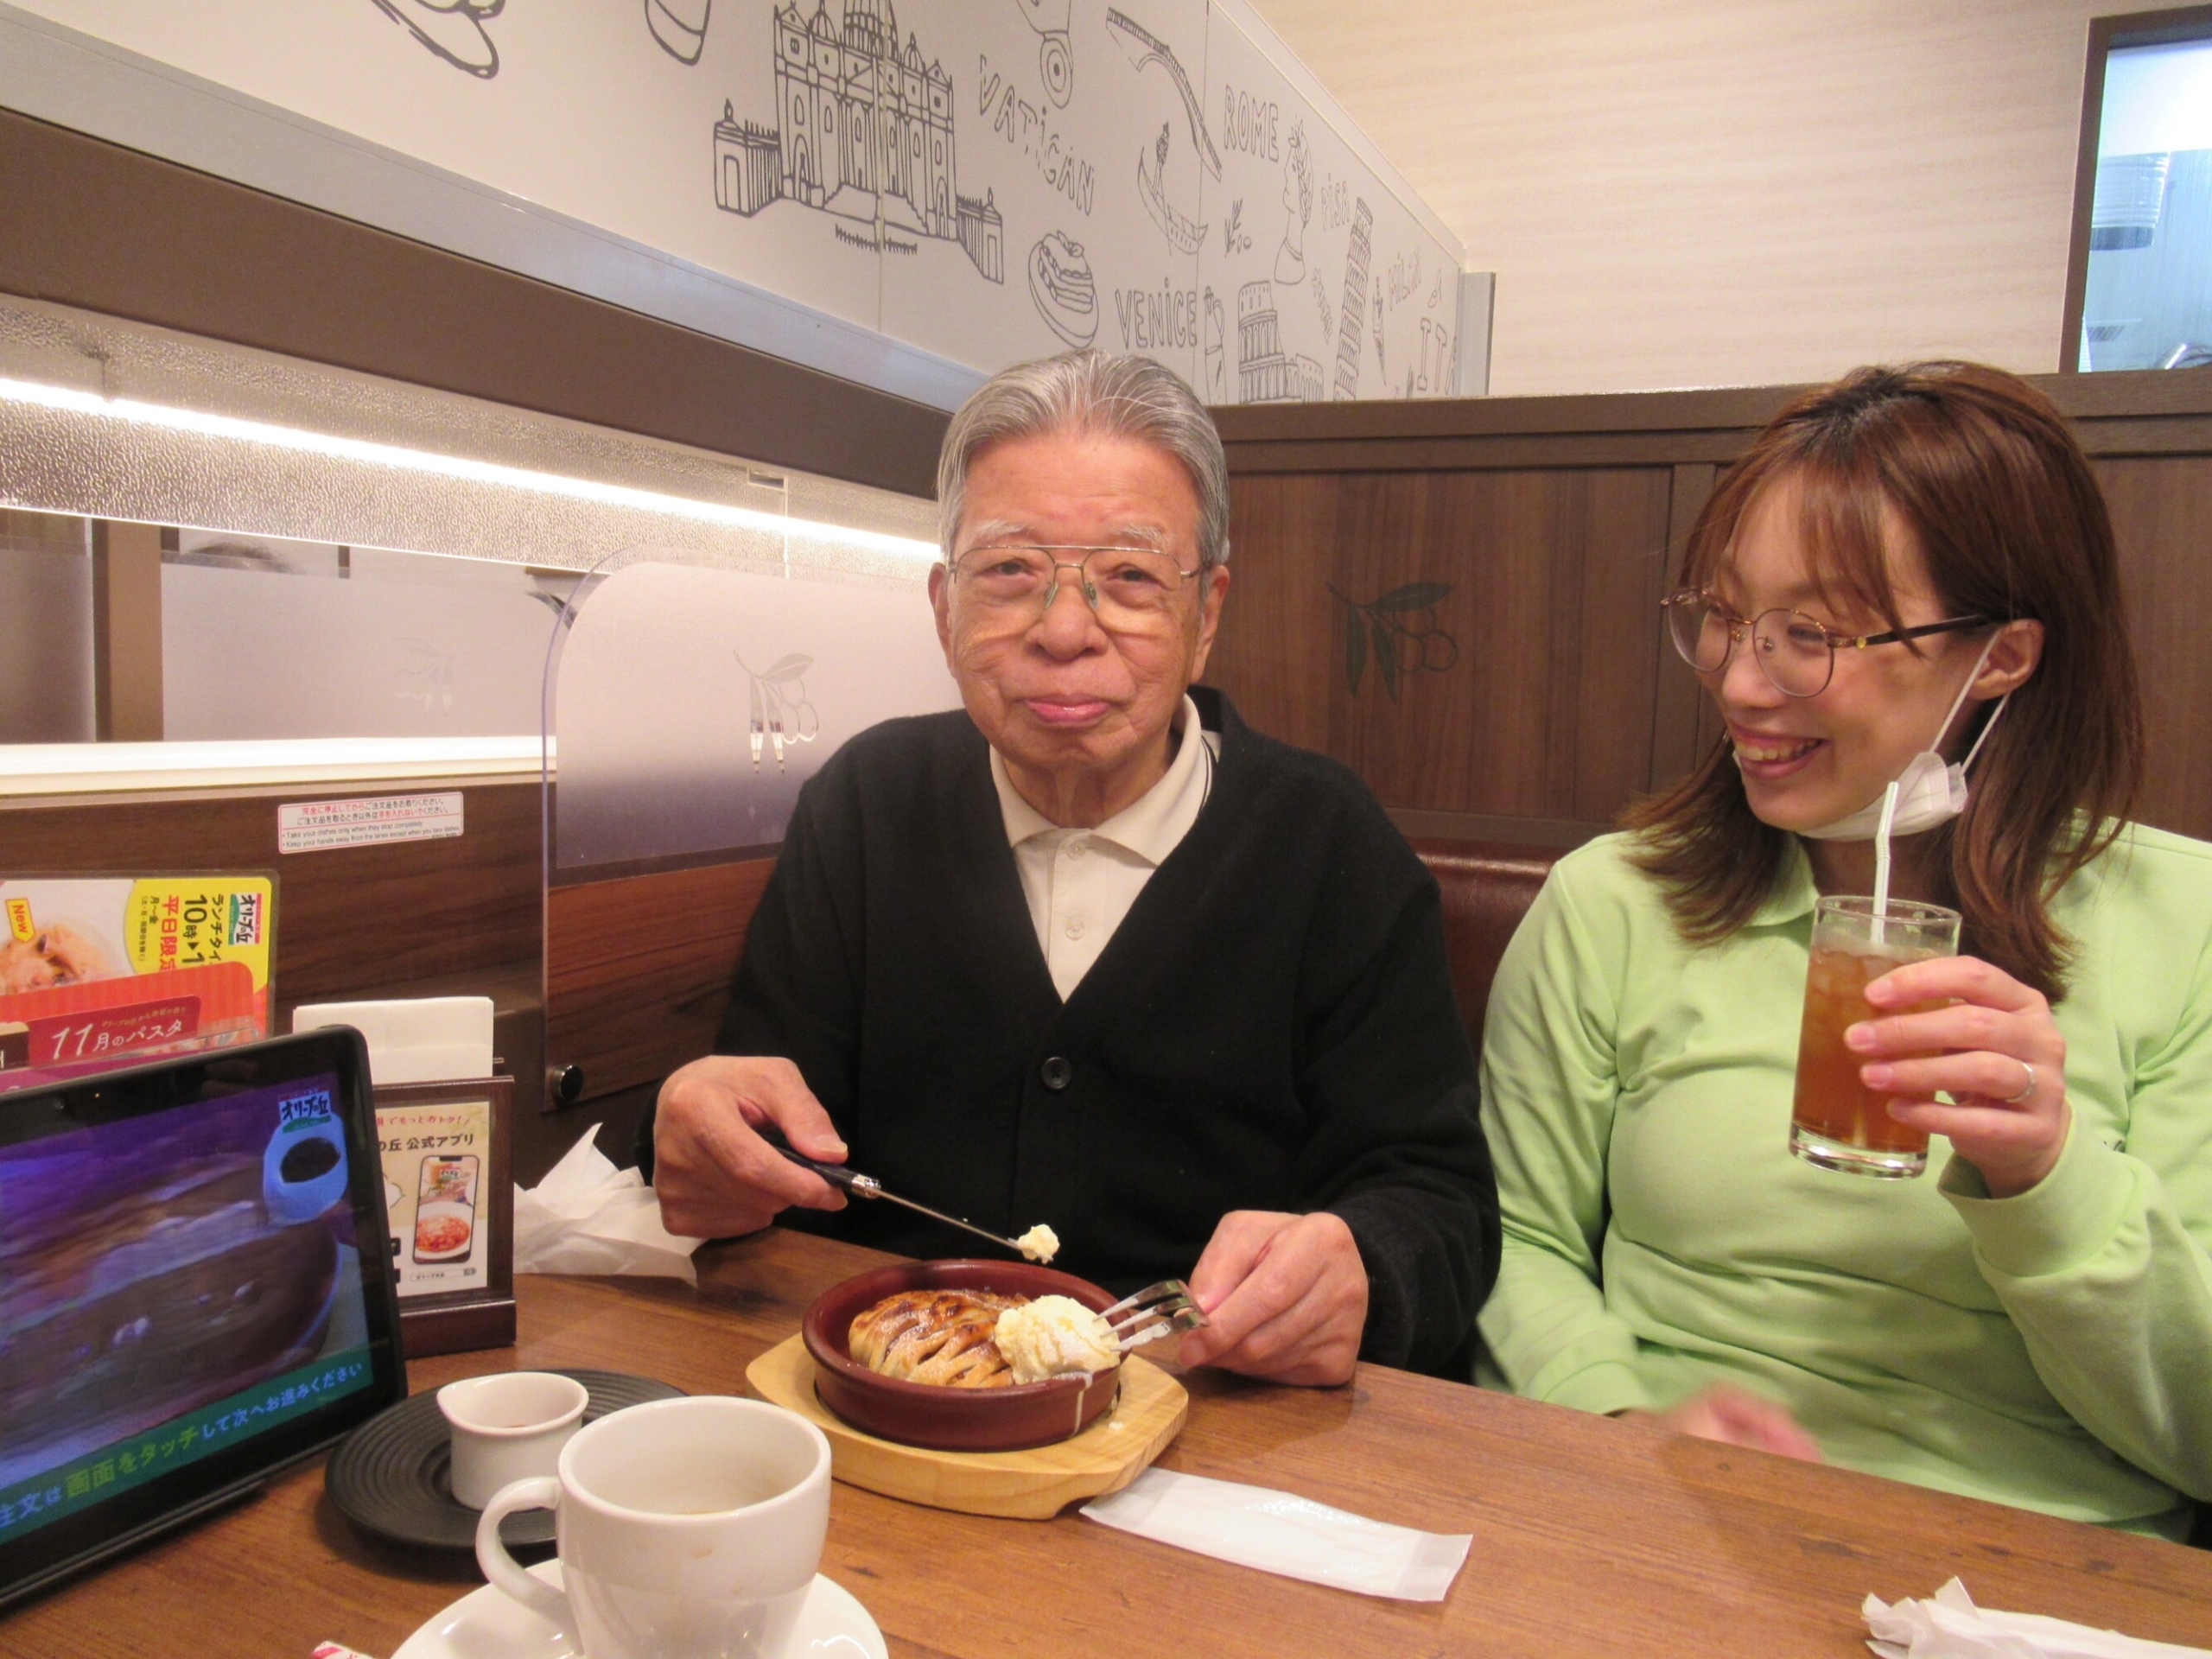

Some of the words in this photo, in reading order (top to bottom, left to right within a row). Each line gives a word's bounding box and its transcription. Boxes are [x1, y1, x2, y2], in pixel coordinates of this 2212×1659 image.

[1224, 85, 1279, 162] ROME
[286, 840, 302, 849] Keep
[302, 839, 316, 848] your
[390, 830, 407, 839] except
[302, 830, 316, 838] your
[338, 827, 350, 836] only
[14, 904, 28, 934] New
[208, 893, 224, 963] ランチタイ
[236, 893, 256, 944] オリーブの丘
[52, 1019, 184, 1061] 11月のパスタ
[282, 1096, 328, 1121] オリーブの丘
[406, 1133, 474, 1150] 公式アプリ
